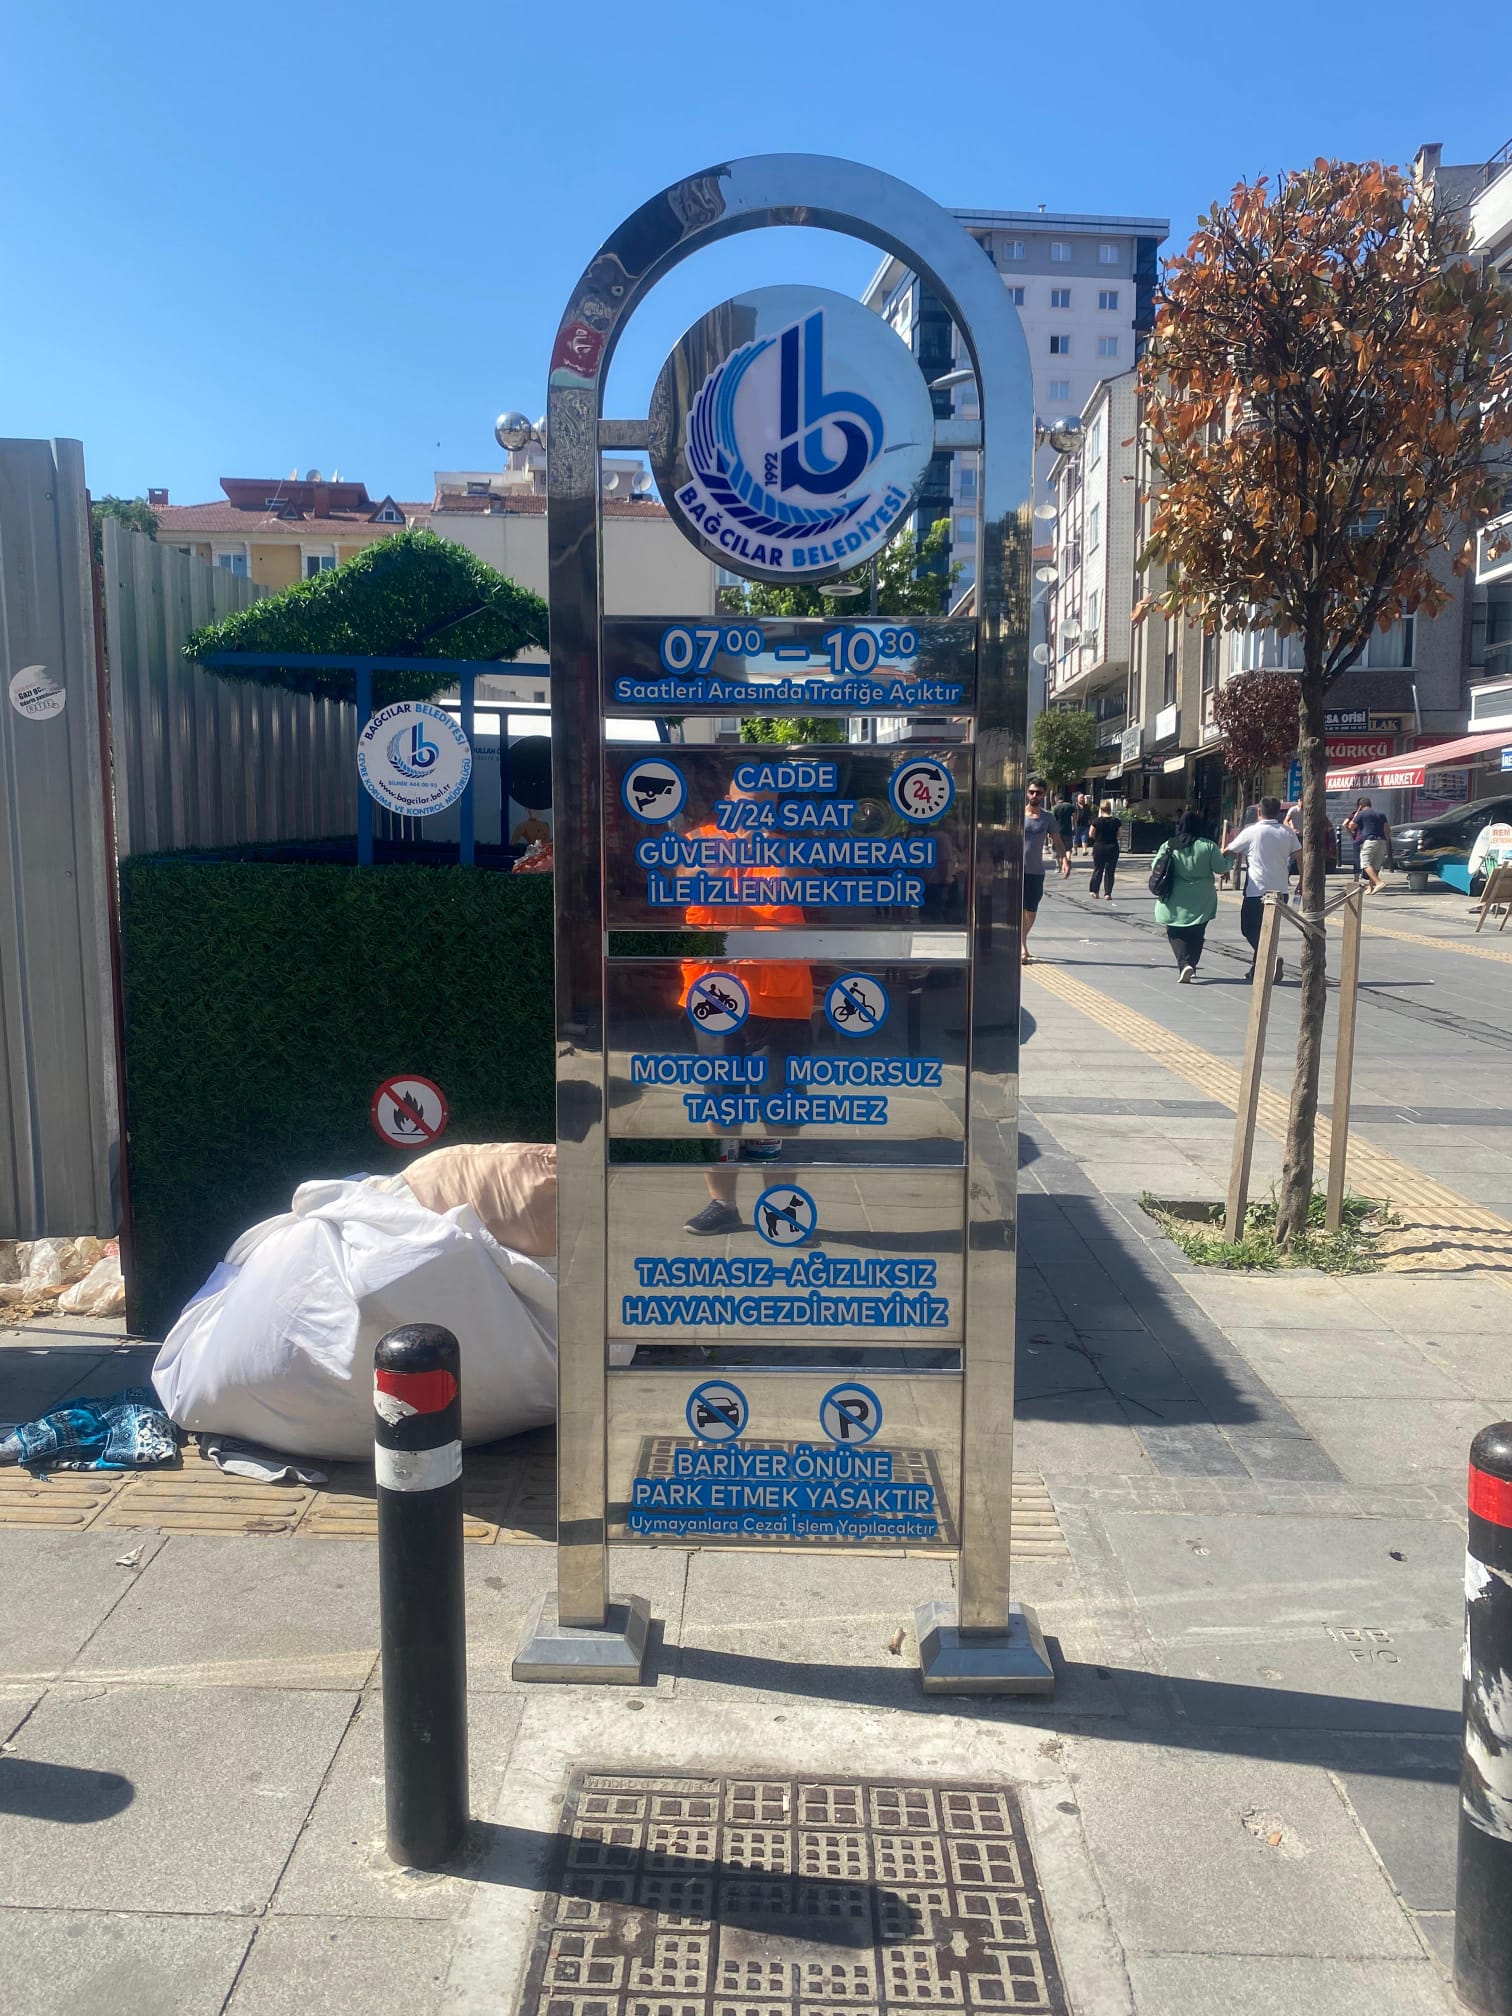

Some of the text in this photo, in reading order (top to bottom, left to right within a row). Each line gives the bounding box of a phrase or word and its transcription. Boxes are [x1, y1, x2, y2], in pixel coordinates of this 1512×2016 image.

[765, 452, 778, 487] 1992
[679, 485, 907, 567] BAĞCILAR BELEDİYESİ
[618, 681, 960, 704] Saatleri Arasında Trafiğe Açıktır
[1325, 742, 1387, 760] KÜRKÇÜ
[736, 767, 834, 789] CADDE
[1383, 772, 1415, 786] MARKET
[407, 802, 445, 816] KONTROL
[718, 804, 853, 829] 7/24 SAAT
[640, 837, 933, 865] GÜVENLİK KAMERASI
[651, 874, 921, 903] İLE İZLENMEKTEDİR
[634, 1060, 940, 1084] MOTORLU MOTORSUZ
[687, 1093, 884, 1124] TAŞIT GİREMEZ
[625, 1296, 946, 1325] HAYVAN GEZDİRMEYİNİZ
[678, 1449, 889, 1479] BARİYER ÖNÜNE
[636, 1485, 930, 1511] PARK ETMEK YASAKTIR
[631, 1513, 935, 1538] Uymayanlara Cezai İşlem Yapılacaktır
